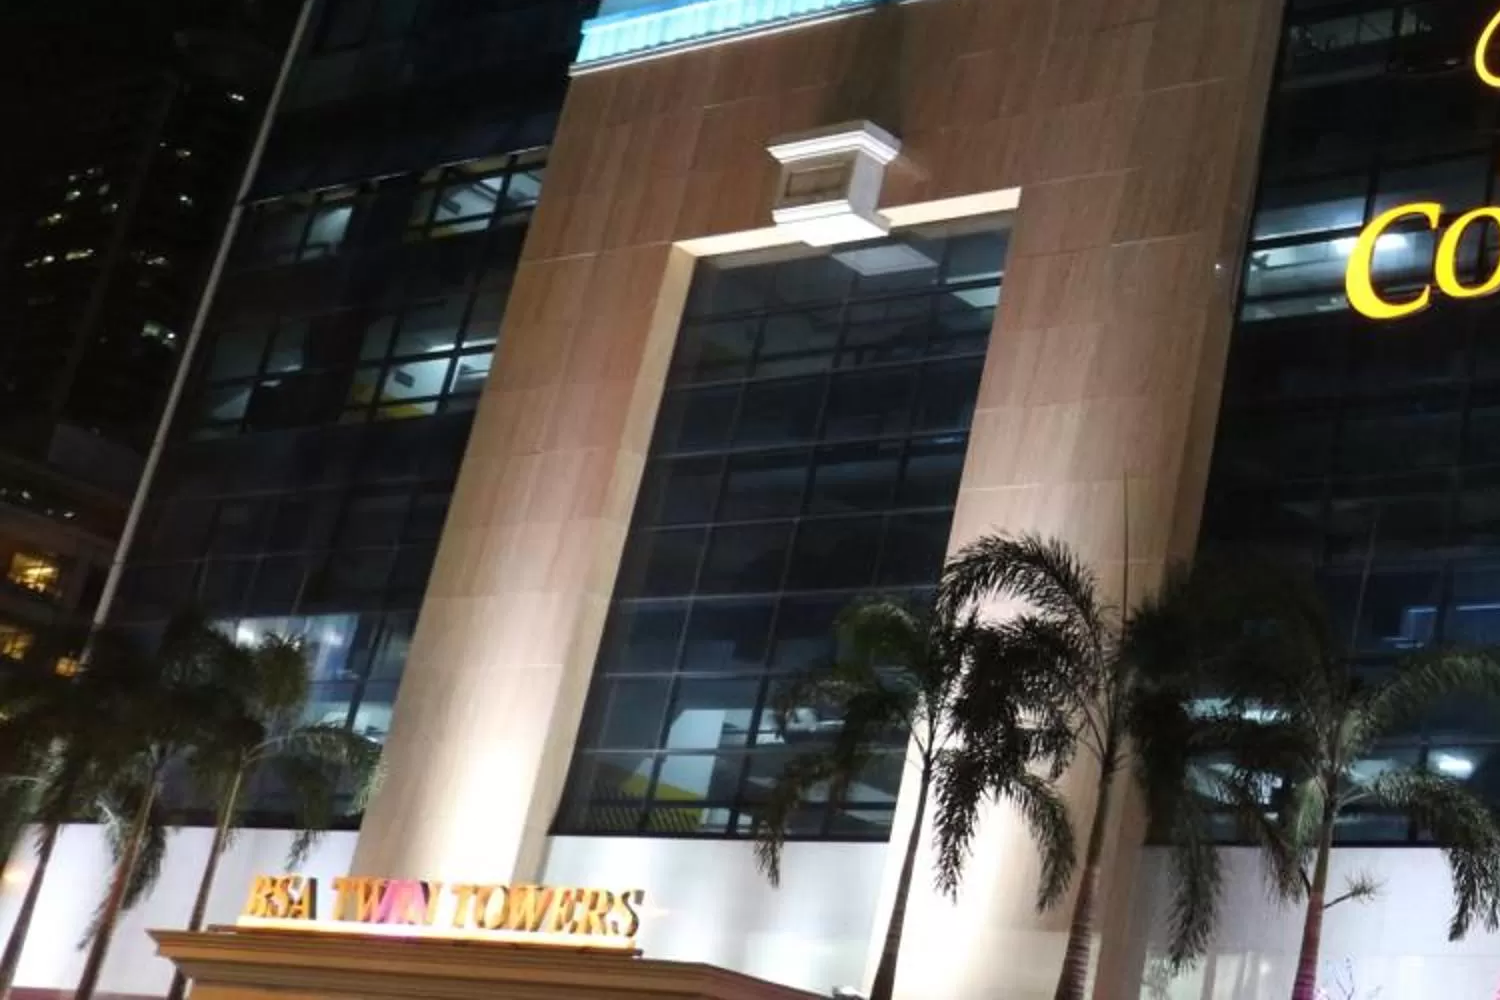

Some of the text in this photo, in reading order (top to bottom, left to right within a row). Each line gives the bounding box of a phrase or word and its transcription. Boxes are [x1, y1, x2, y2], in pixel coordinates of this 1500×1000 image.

[246, 875, 645, 938] BSA TWIN TOWERS
